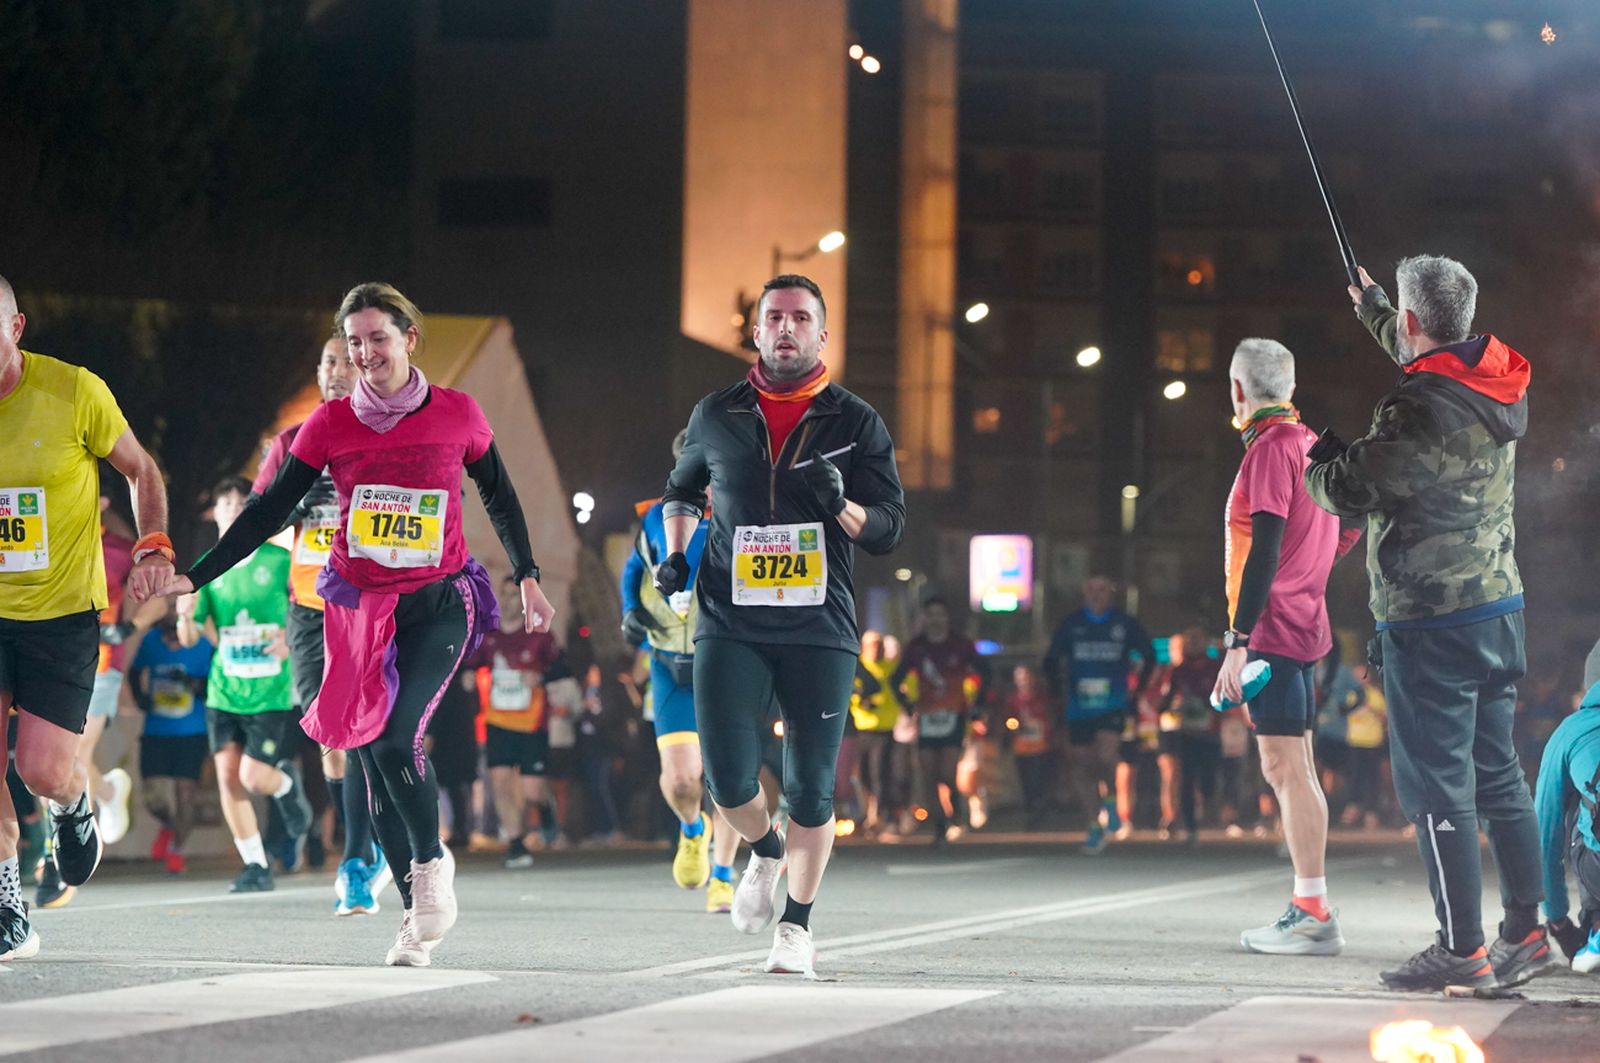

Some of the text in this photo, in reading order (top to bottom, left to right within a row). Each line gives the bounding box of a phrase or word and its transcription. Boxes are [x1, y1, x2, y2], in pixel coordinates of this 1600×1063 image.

[373, 492, 400, 502] NOCHE
[401, 495, 413, 503] DE
[361, 501, 380, 510] SAN
[370, 513, 422, 540] 1745
[753, 534, 779, 543] NOCHE
[780, 534, 791, 542] DE
[742, 544, 760, 553] SAN
[752, 554, 808, 579] 3724
